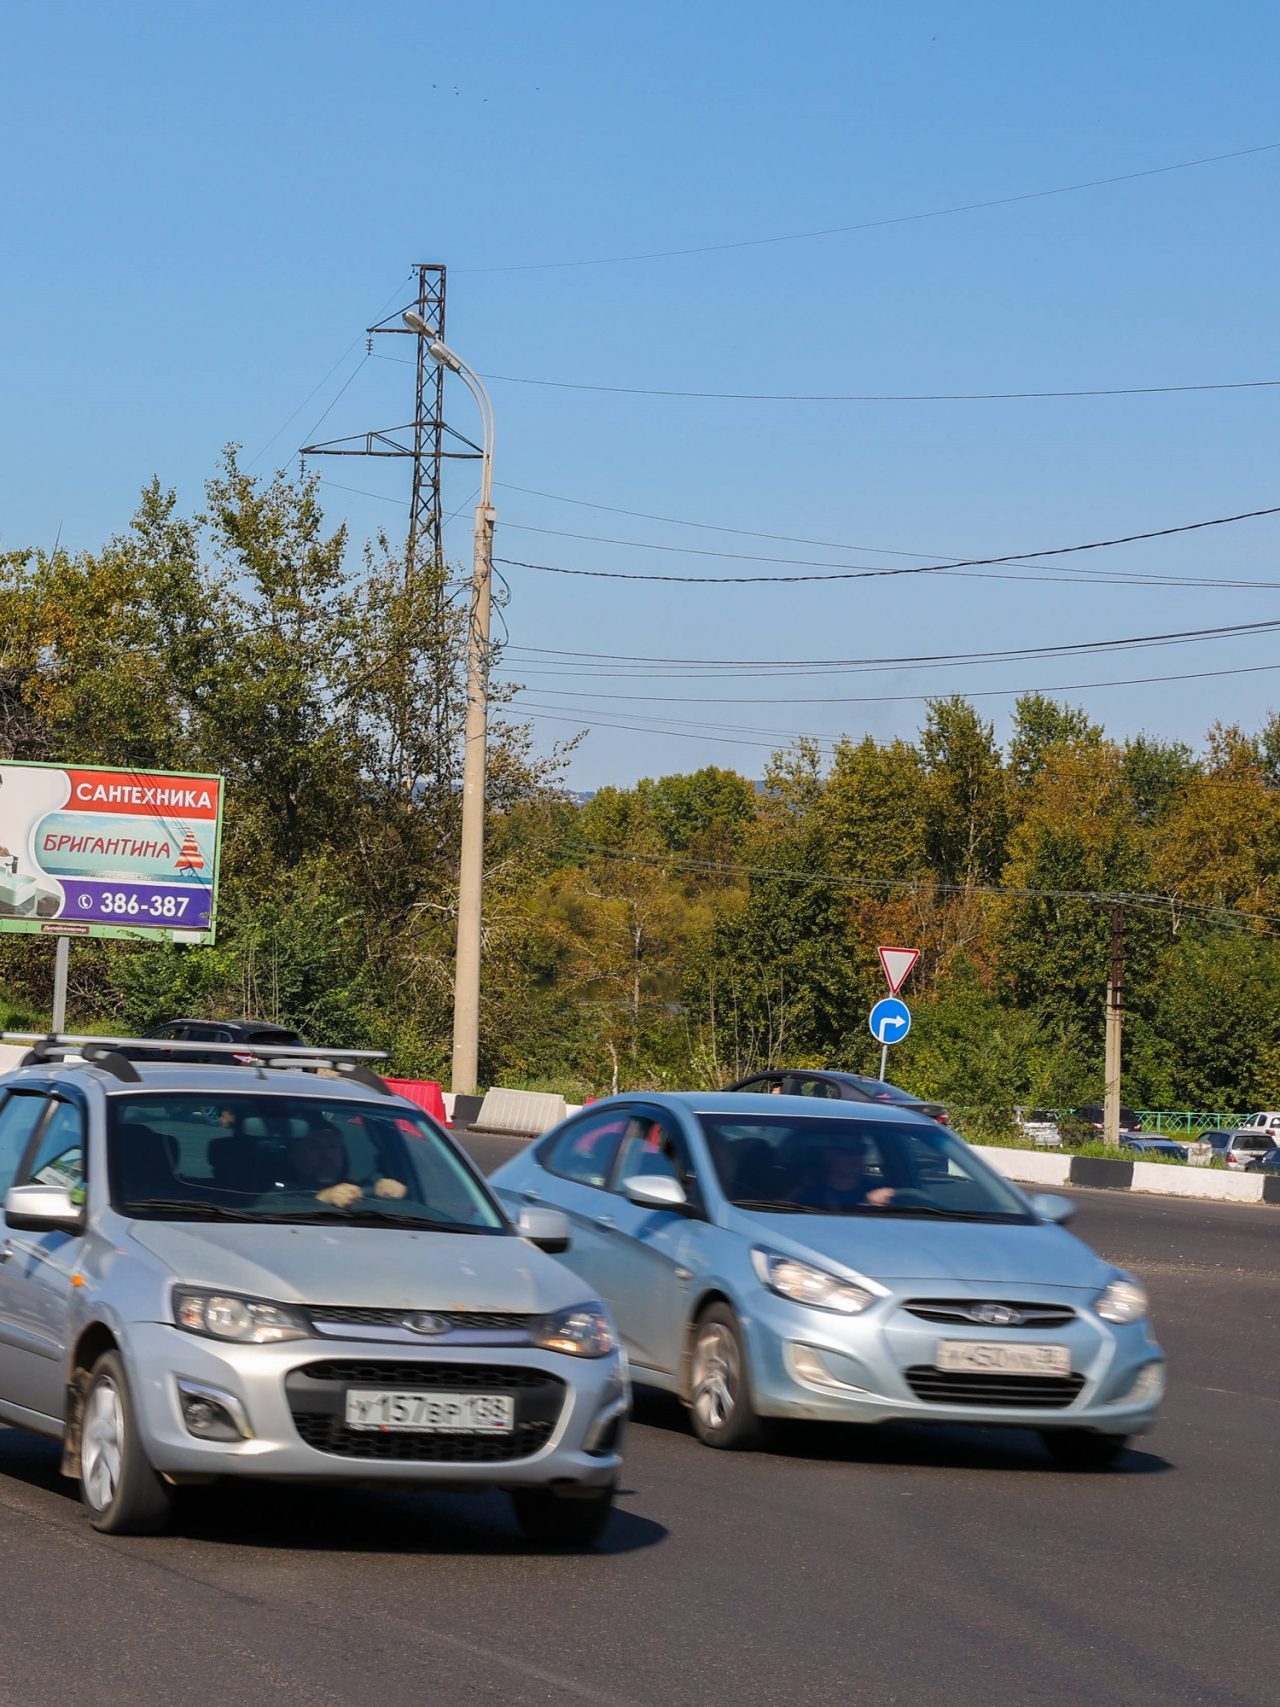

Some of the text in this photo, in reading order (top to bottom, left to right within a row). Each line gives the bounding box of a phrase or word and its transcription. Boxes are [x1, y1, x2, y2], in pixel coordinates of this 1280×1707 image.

[76, 783, 212, 809] САНТЕХНИКА
[43, 834, 171, 860] БРИГАНТИНА
[100, 892, 190, 918] 386-387
